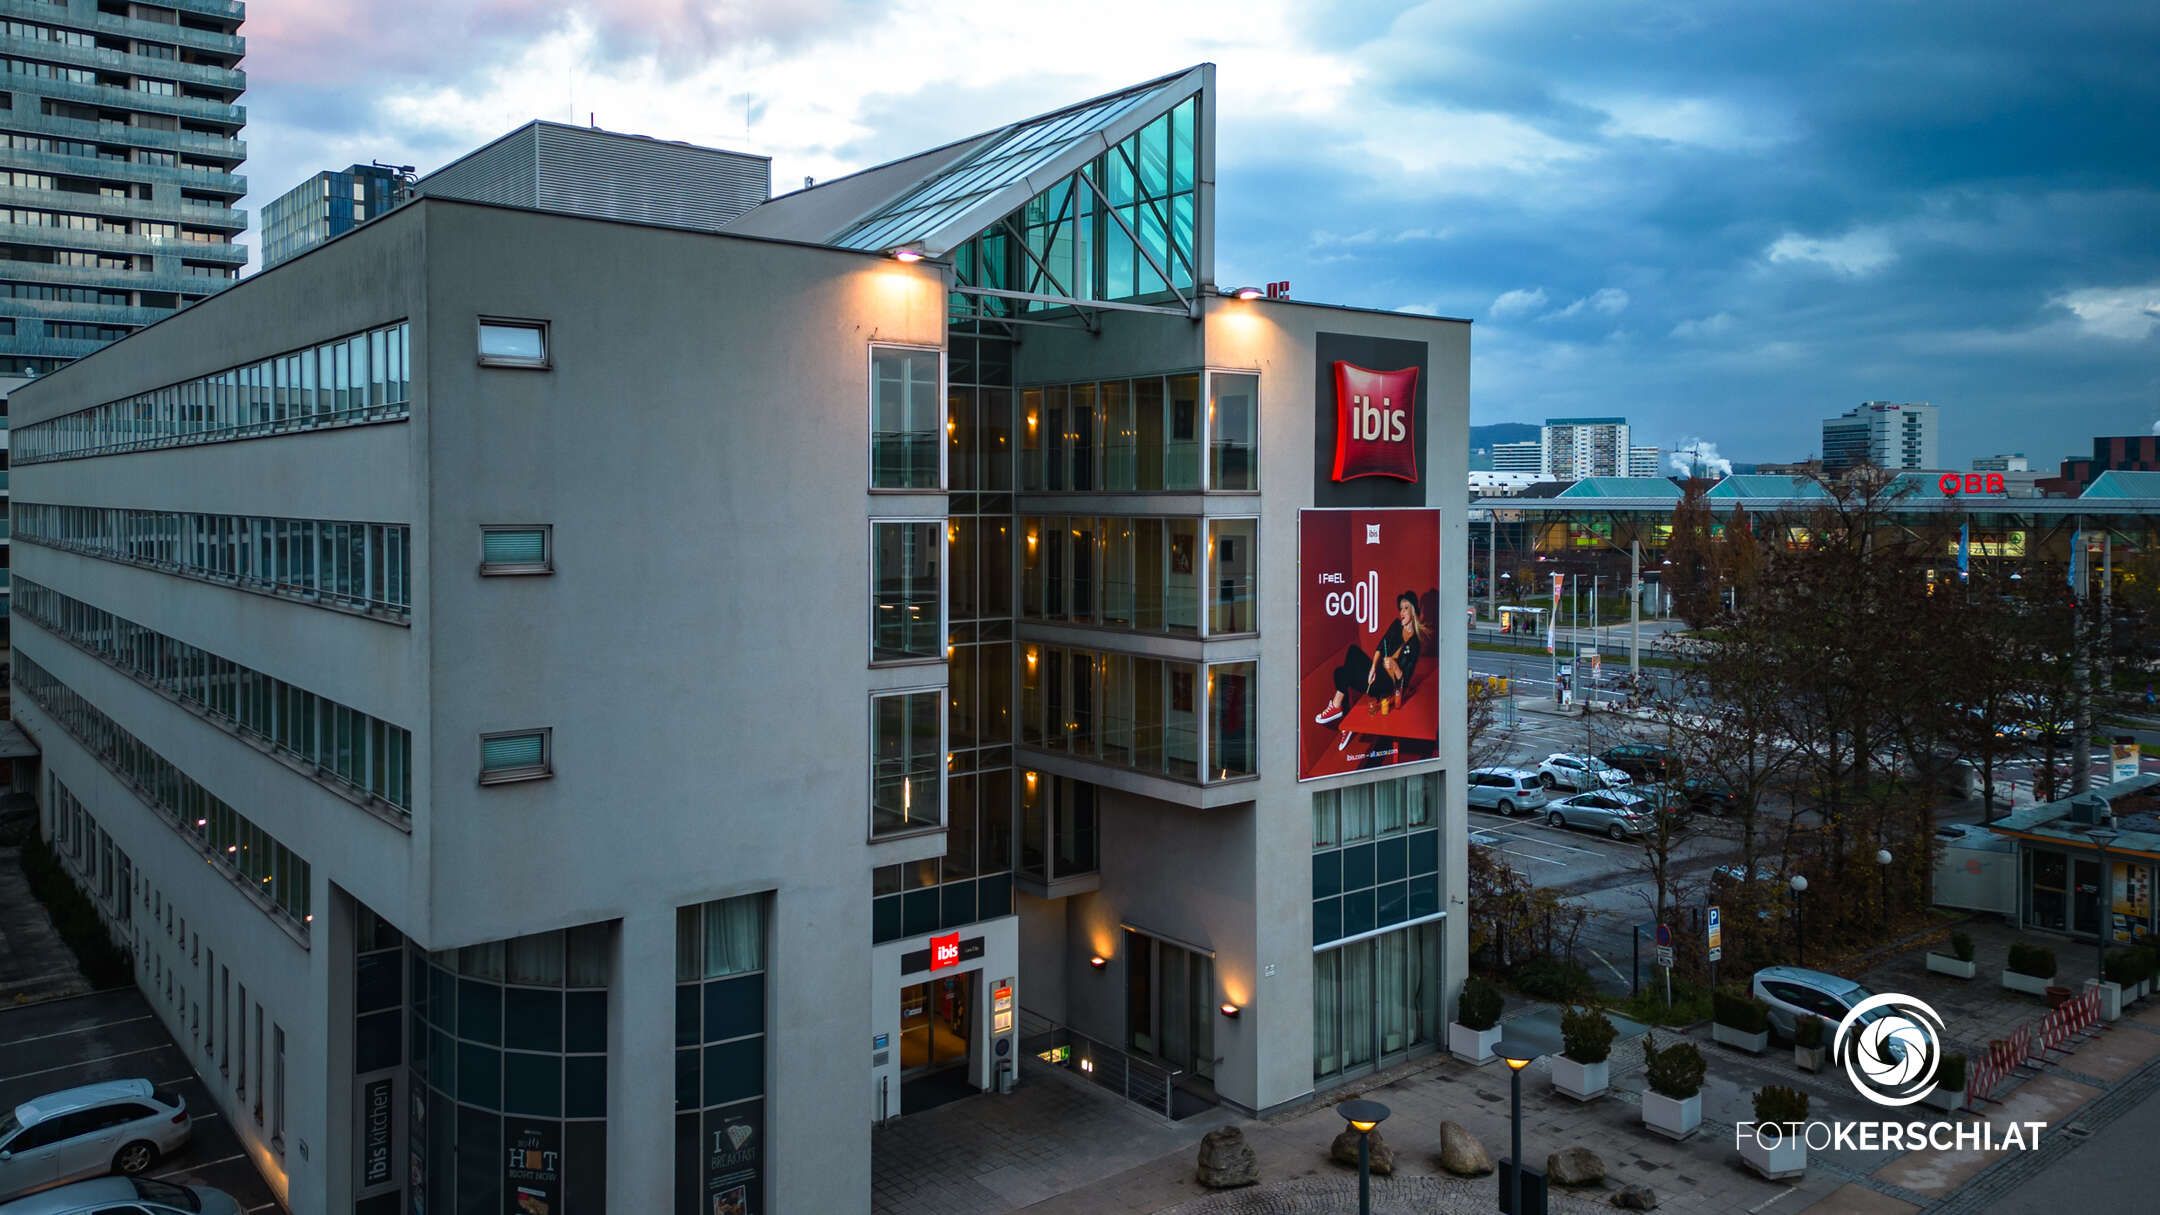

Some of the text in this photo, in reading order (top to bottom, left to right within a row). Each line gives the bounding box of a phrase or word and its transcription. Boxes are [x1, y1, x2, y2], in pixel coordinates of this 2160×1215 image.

[1353, 395, 1406, 442] ibis
[1323, 573, 1345, 584] FEEL
[1326, 570, 1379, 633] GOOD
[1711, 910, 1717, 924] P
[938, 944, 958, 960] ibis
[368, 1084, 388, 1180] ibis kitchen
